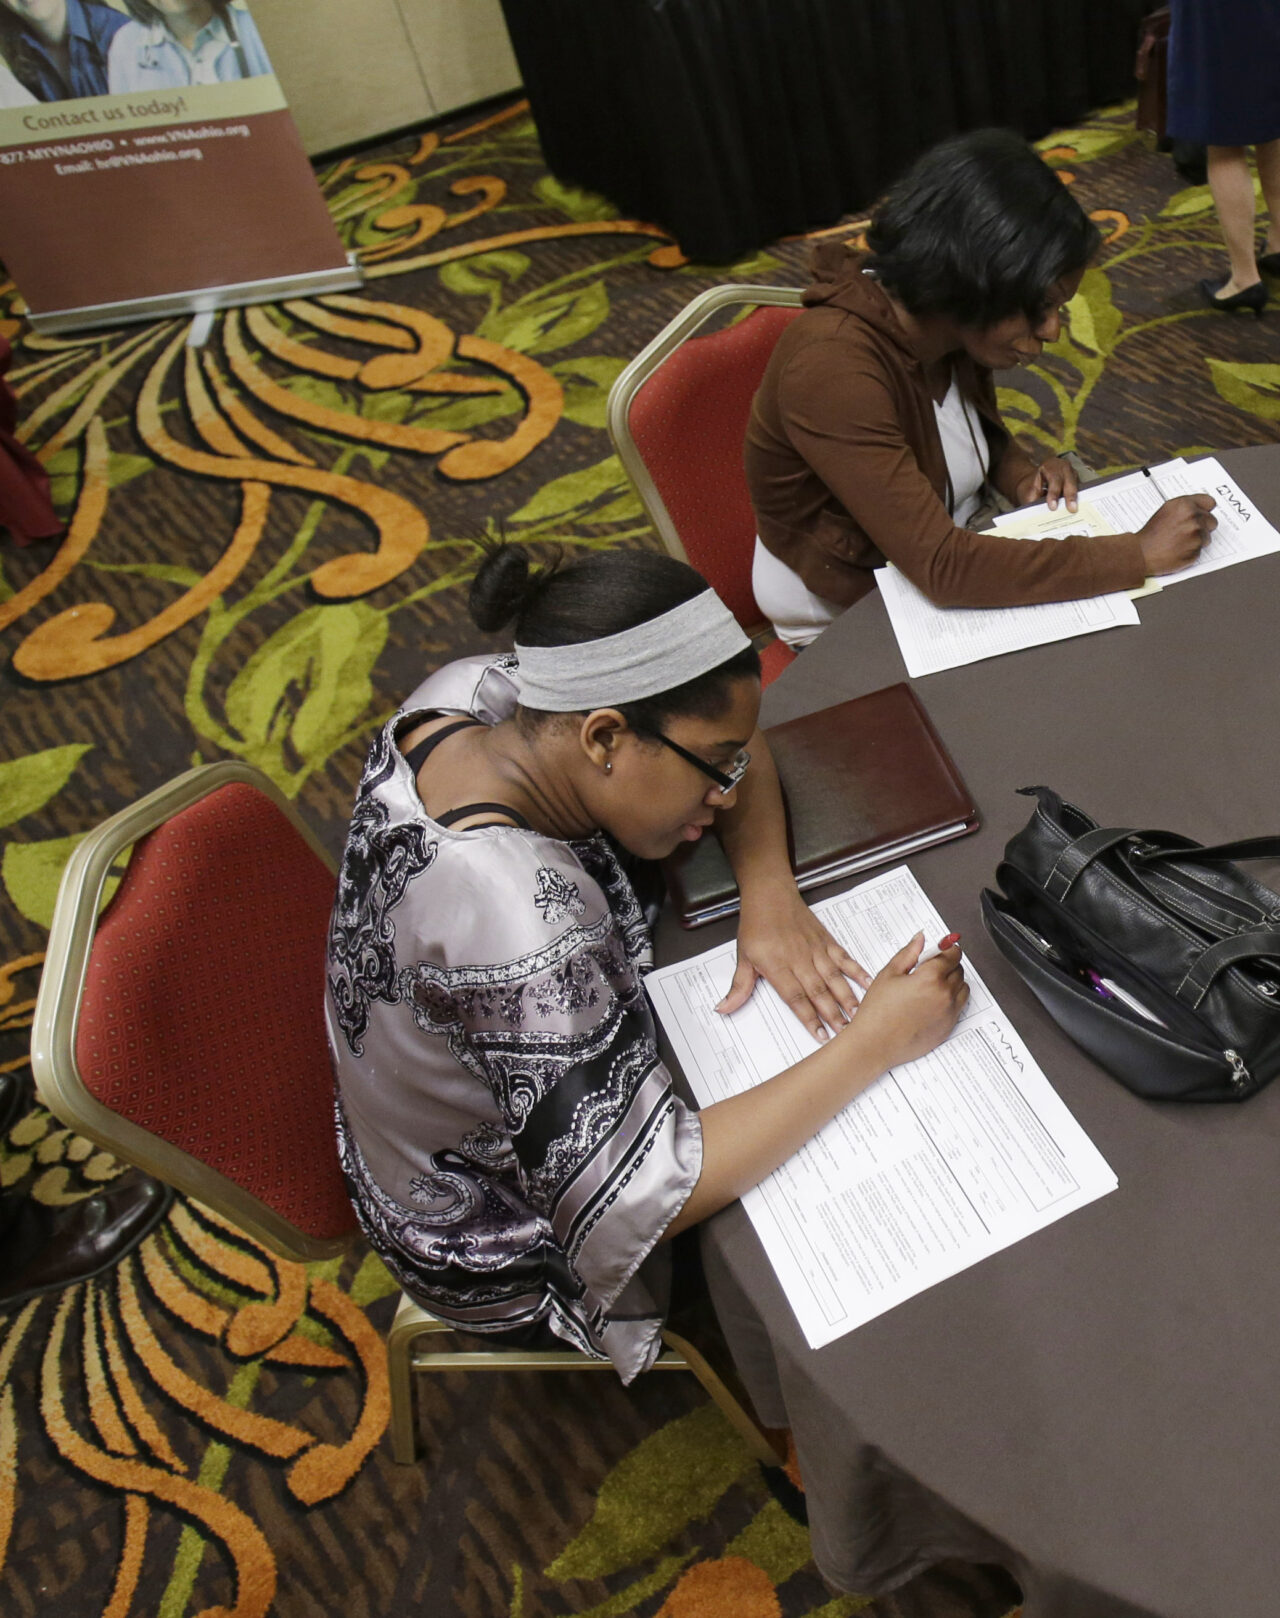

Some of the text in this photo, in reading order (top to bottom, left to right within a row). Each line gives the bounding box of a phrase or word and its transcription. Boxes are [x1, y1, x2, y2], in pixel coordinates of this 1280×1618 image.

[22, 96, 188, 131] Contact us today!
[1228, 494, 1251, 522] VNA
[1001, 1033, 1024, 1072] VNA
